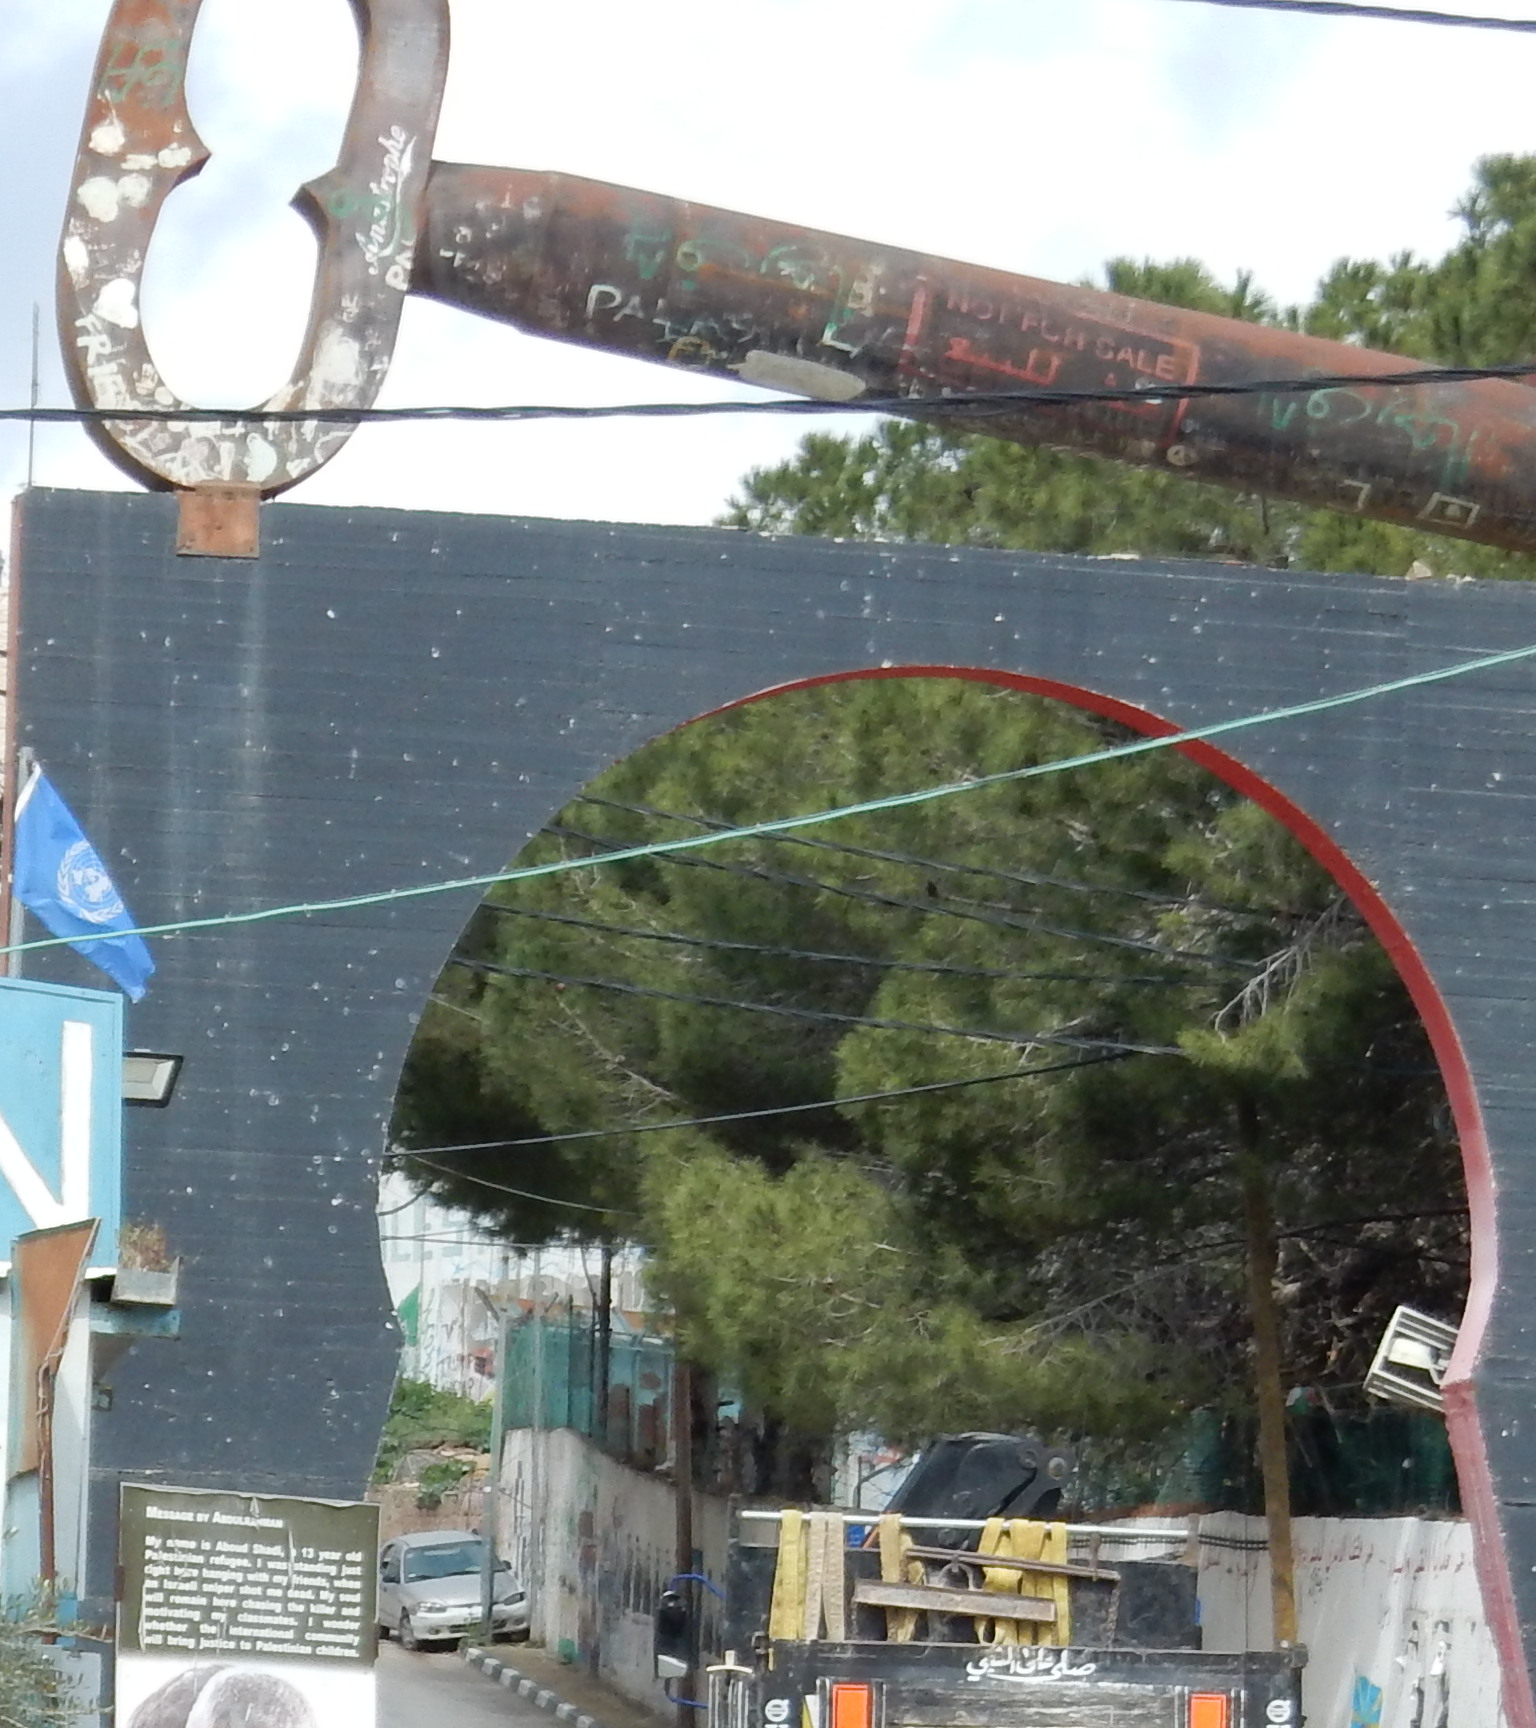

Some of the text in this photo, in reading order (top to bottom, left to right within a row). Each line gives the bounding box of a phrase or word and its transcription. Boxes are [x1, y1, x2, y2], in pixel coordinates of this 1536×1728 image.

[947, 292, 1006, 325] NOT
[1095, 337, 1175, 381] SALE
[145, 1535, 162, 1548] My
[166, 1539, 196, 1549] name
[201, 1539, 211, 1550] is
[302, 1548, 313, 1558] 13
[319, 1552, 342, 1561] year
[345, 1552, 362, 1562] old
[145, 1549, 361, 1576] Palestinian refugee. I was standing just
[144, 1564, 170, 1576] right
[247, 1572, 269, 1582] with
[272, 1575, 288, 1586] my
[292, 1574, 329, 1588] friends,
[333, 1578, 361, 1589] when
[145, 1579, 360, 1603] an Israeli sniper shot me dead. My soul
[145, 1592, 360, 1616] will remain here chasing the killer and
[145, 1607, 200, 1621] motivating
[211, 1612, 227, 1623] my
[237, 1613, 298, 1626] classmates.
[308, 1617, 313, 1626] I
[144, 1634, 359, 1657] will bring justice to Palestinian children.
[145, 1620, 188, 1632] whether
[200, 1623, 217, 1634] the
[305, 1632, 360, 1646] community
